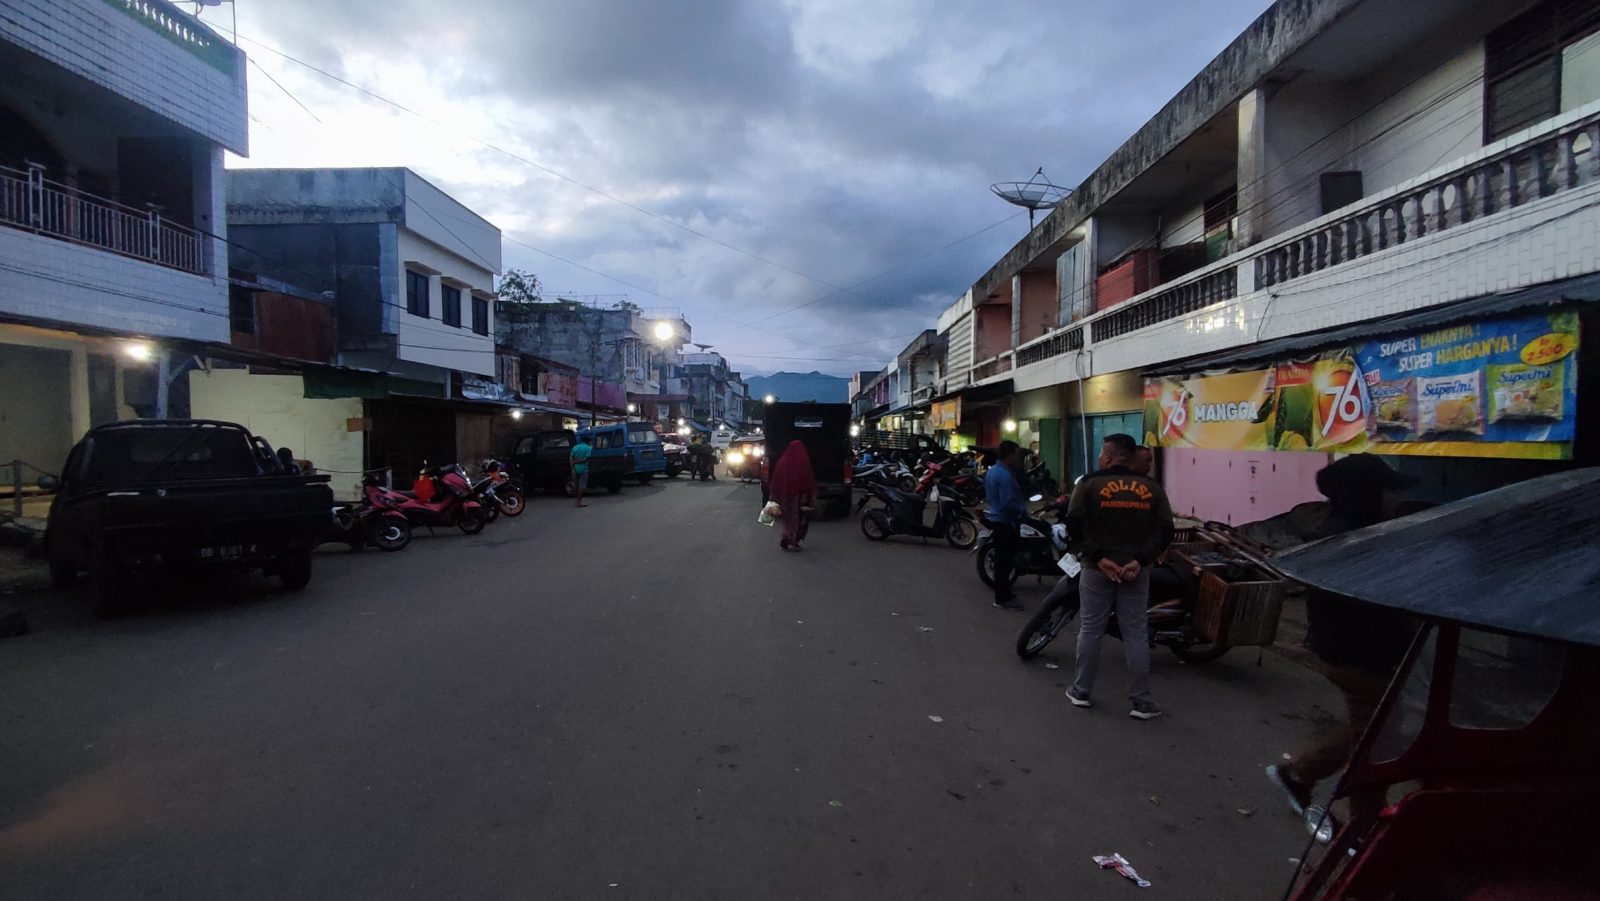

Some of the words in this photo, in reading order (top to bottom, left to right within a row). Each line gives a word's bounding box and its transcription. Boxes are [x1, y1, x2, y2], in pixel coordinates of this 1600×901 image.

[1380, 337, 1417, 357] SUPER
[1398, 351, 1433, 372] SUPER
[1163, 388, 1188, 436] 76
[1194, 401, 1258, 422] MANGGA
[1322, 366, 1363, 437] 76
[1099, 479, 1153, 500] POLISI
